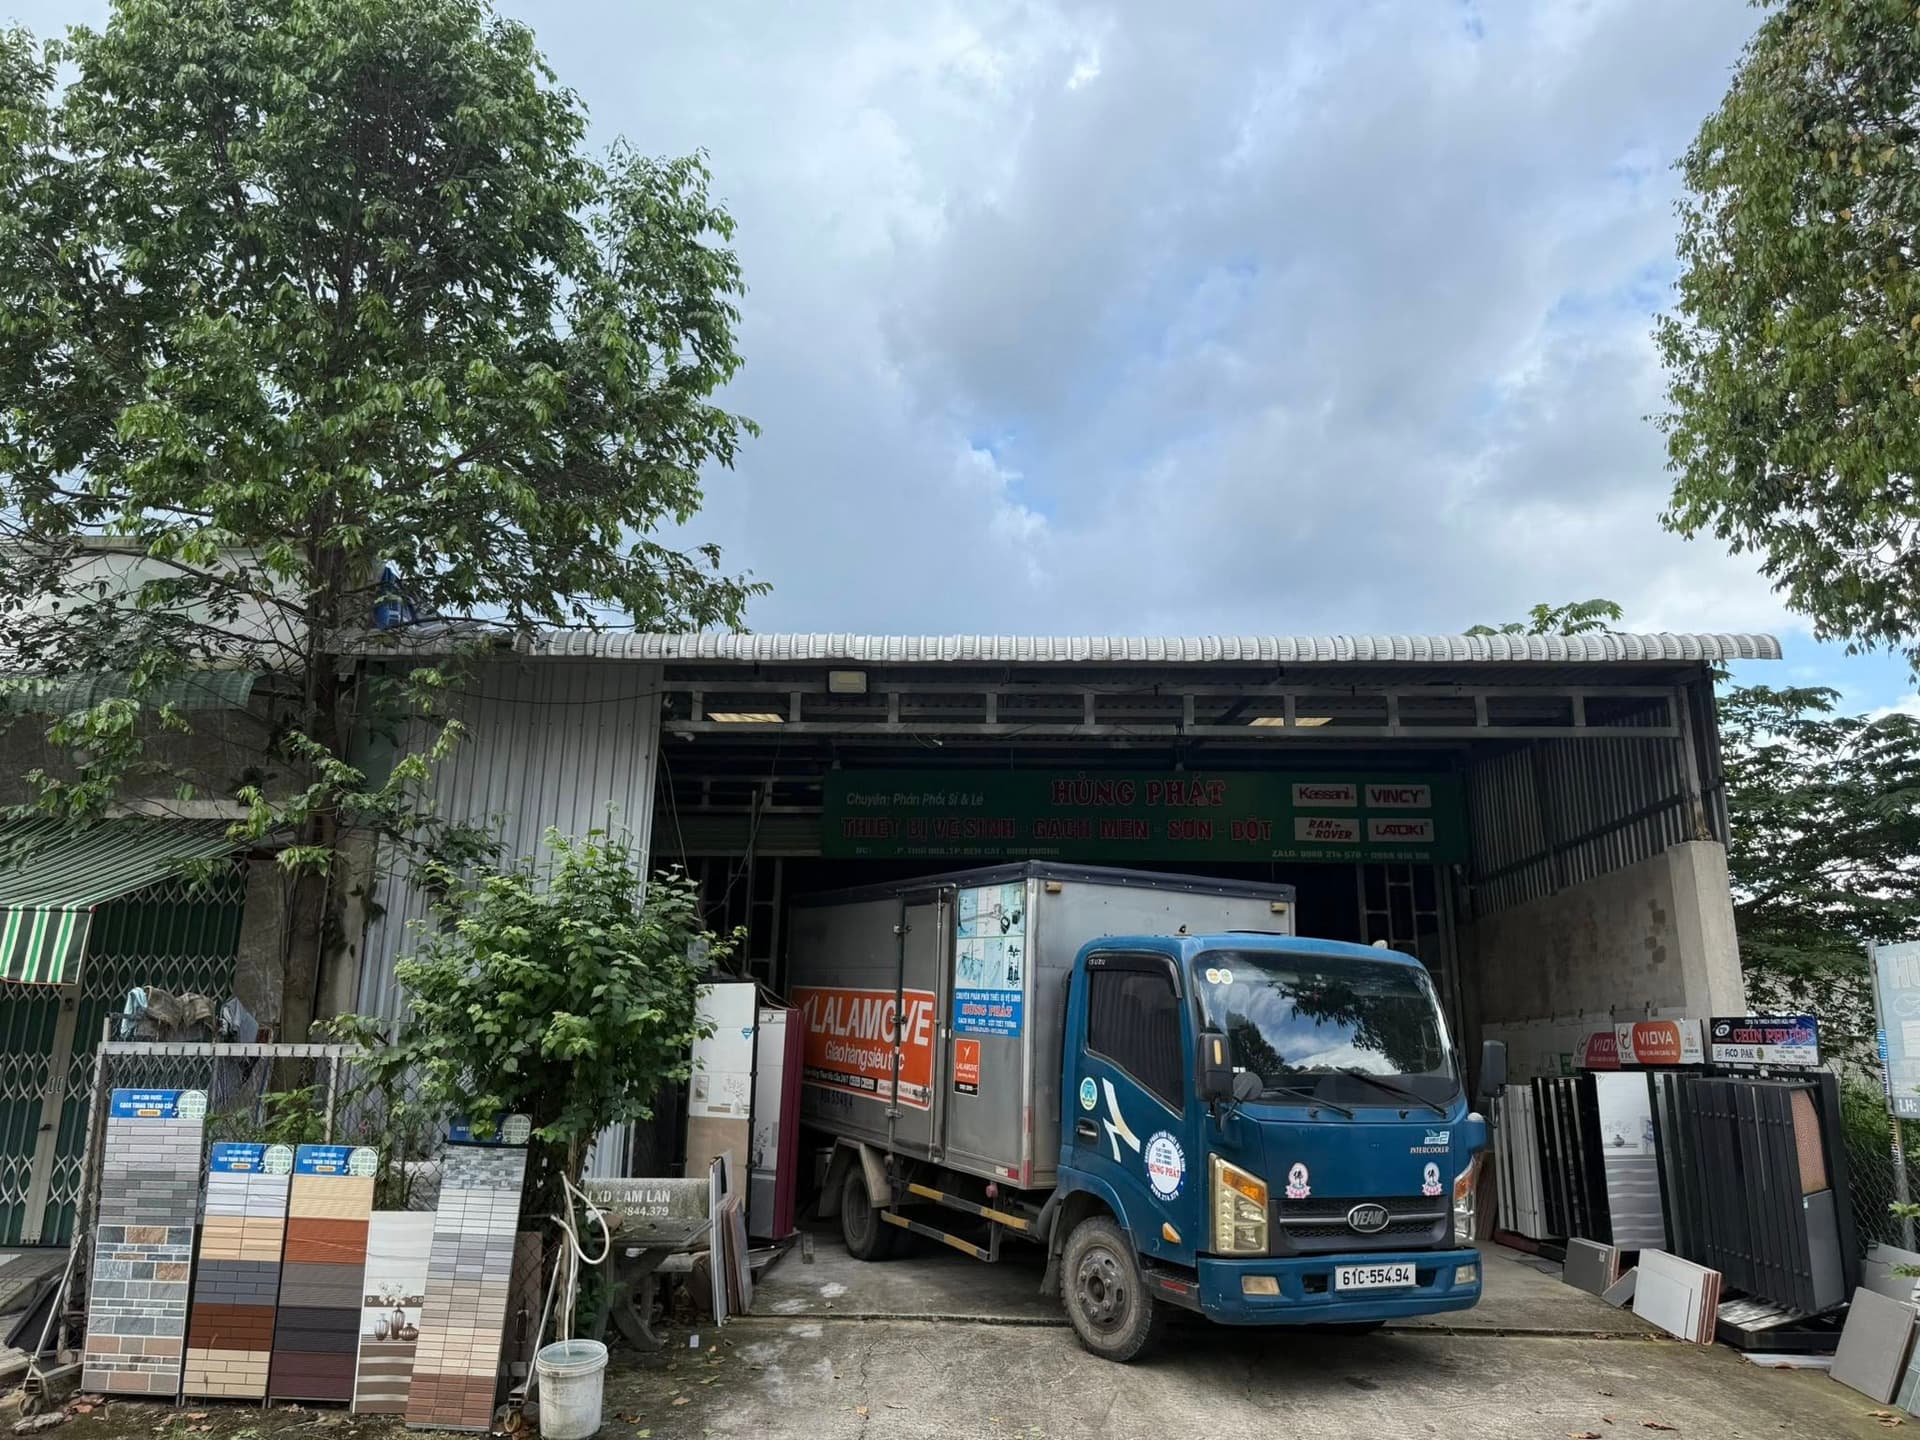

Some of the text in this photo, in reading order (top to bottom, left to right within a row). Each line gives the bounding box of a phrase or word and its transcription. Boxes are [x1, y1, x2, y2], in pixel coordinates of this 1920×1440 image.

[1144, 771, 1227, 807] PHÁT
[1298, 787, 1351, 801] Kassani
[1371, 788, 1421, 803] VINCY
[960, 794, 970, 806] &
[961, 816, 1016, 841] SINH
[1100, 817, 1149, 841] MEN
[1231, 814, 1272, 846] BỘT
[1308, 820, 1333, 829] RAN
[1314, 830, 1353, 840] ROVER
[810, 994, 934, 1047] LALAMOVE
[1594, 1039, 1619, 1053] VIOV
[1637, 1031, 1675, 1046] VIOVA
[1900, 1098, 1918, 1113] LH:
[1410, 1146, 1450, 1154] INTERCOOLER
[1353, 1210, 1384, 1225] VEAM
